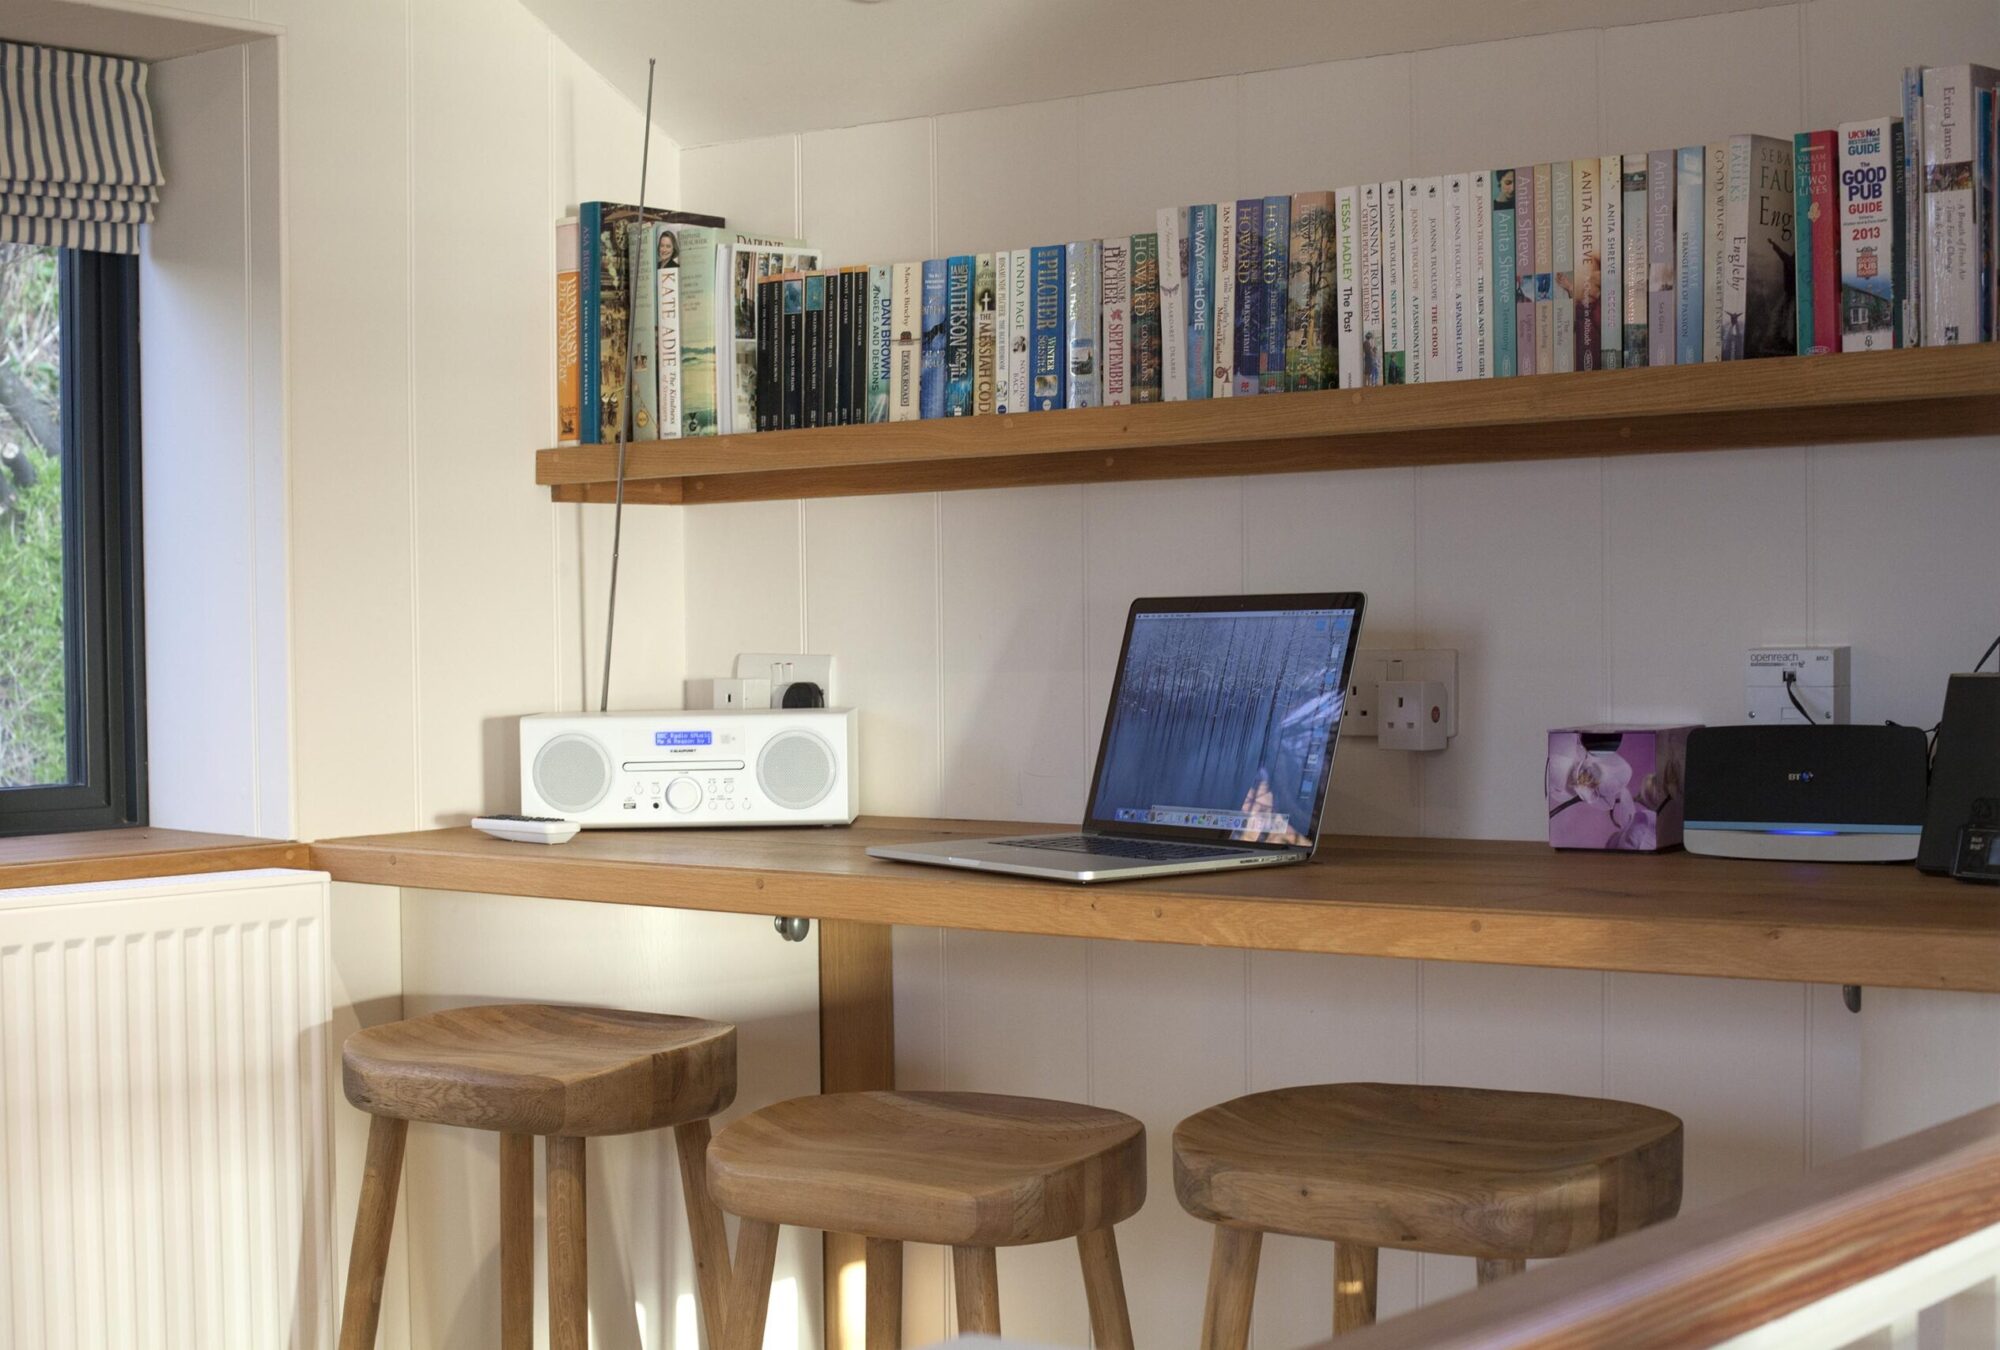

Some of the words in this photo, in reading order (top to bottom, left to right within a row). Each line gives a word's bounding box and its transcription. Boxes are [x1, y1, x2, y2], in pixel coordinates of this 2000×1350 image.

[1942, 86, 1956, 119] Erica
[1848, 143, 1880, 156] GUIDE
[1942, 121, 1956, 160] James
[1654, 160, 1667, 200] Anita
[1715, 150, 1724, 192] GOOD
[1730, 144, 1741, 203] FAULKS
[1798, 163, 1826, 174] SETH
[1798, 175, 1827, 187] TWO
[1842, 166, 1886, 186] GOOD
[1518, 176, 1530, 215] Anita
[1536, 174, 1549, 213] Anita
[1555, 172, 1568, 210] Anita
[1581, 170, 1592, 212] ANITA
[1799, 186, 1828, 197] LIVES
[1848, 183, 1882, 202] PUB
[1848, 201, 1882, 215] GUIDE
[1341, 196, 1351, 232] TESSA
[1369, 203, 1379, 256] JOANNA
[1389, 203, 1397, 238] JOANNA
[1411, 208, 1419, 242] JOANNA
[1454, 205, 1463, 240] JOANNA
[1476, 196, 1484, 227] JOANNA
[1607, 203, 1615, 234] ANITA
[1654, 204, 1667, 253] Shreve
[1715, 195, 1724, 242] WIVES?
[1958, 211, 1966, 236] Breath
[582, 226, 590, 247] ASA
[1195, 228, 1205, 260] WAY
[1237, 207, 1251, 284] HOWARD
[1263, 205, 1278, 285] HOWARD
[1430, 218, 1438, 254] JOANNA
[1498, 213, 1511, 253] Anita
[1518, 218, 1530, 266] Shreve
[1536, 216, 1549, 264] Shreve
[1555, 214, 1568, 262] Shreve
[1581, 216, 1592, 265] SHREVE
[1852, 226, 1880, 241] 2013
[1958, 237, 1966, 246] of
[582, 250, 590, 291] BRIGGS
[1147, 236, 1156, 289] ELIZABETH
[1196, 261, 1204, 287] BACK
[1343, 235, 1352, 281] HADLEY
[1389, 240, 1397, 285] TROLLOPE
[1454, 243, 1463, 288] TROLLOPE
[1607, 237, 1615, 275] SHREVE
[1729, 236, 1746, 292] Engleby
[1859, 262, 1876, 270] PUB
[1958, 247, 1966, 267] Fresh
[1958, 268, 1966, 281] Air
[1016, 256, 1024, 297] LYNDA
[1037, 258, 1058, 330] PILCHER
[1104, 246, 1120, 305] PILCHER
[1117, 249, 1127, 303] ROSAMUNDE
[1133, 235, 1147, 316] HOWARD
[1369, 262, 1379, 326] TROLLOPE
[1430, 256, 1438, 301] TROLLOPE
[1476, 276, 1484, 295] THE
[1498, 256, 1511, 303] Shreve
[1715, 251, 1724, 302] MARGARET
[662, 272, 676, 320] KATE
[872, 285, 880, 322] ANGELS
[881, 298, 891, 326] DAN
[950, 275, 967, 346] PATTERSON
[1147, 292, 1156, 315] JANE
[1195, 288, 1205, 331] HOME
[1343, 287, 1353, 307] The
[1389, 289, 1397, 315] NEXT
[1411, 295, 1419, 303] A
[1430, 304, 1438, 324] THE
[1454, 292, 1463, 300] A
[1476, 297, 1484, 315] MEN
[1607, 290, 1615, 328] RESCUE
[1682, 290, 1688, 301] OF
[558, 280, 568, 385] DICTIONARY
[566, 277, 577, 367] REVERSE
[1016, 302, 1024, 330] PAGE
[1168, 303, 1176, 342] MARGARET
[1344, 311, 1353, 333] Past
[1389, 318, 1397, 330] OF
[1411, 304, 1419, 360] PASSIONATE
[1454, 301, 1463, 340] SPANISH
[1476, 317, 1484, 336] AND
[1501, 308, 1510, 352] Testimony
[1715, 304, 1724, 346] FORSTER
[662, 326, 676, 367] ADIE
[872, 326, 880, 345] AND
[979, 322, 991, 377] MESSIAH
[1047, 337, 1056, 371] WINTER
[1389, 332, 1397, 350] KIN
[1430, 326, 1438, 358] CHOIR
[1476, 338, 1484, 356] THE
[872, 349, 880, 392] DEMONS
[881, 329, 891, 380] BROWN
[949, 363, 959, 383] JILL
[960, 348, 968, 375] JACK
[1019, 359, 1026, 374] NO
[1037, 336, 1047, 373] SOLSTICE
[1109, 324, 1123, 394] SEPTEMBER
[1168, 346, 1176, 379] DRABBLE
[1411, 362, 1419, 383] MAN
[1454, 341, 1463, 373] LOVER
[979, 381, 991, 416] COD
[1750, 653, 1798, 664] openreach
